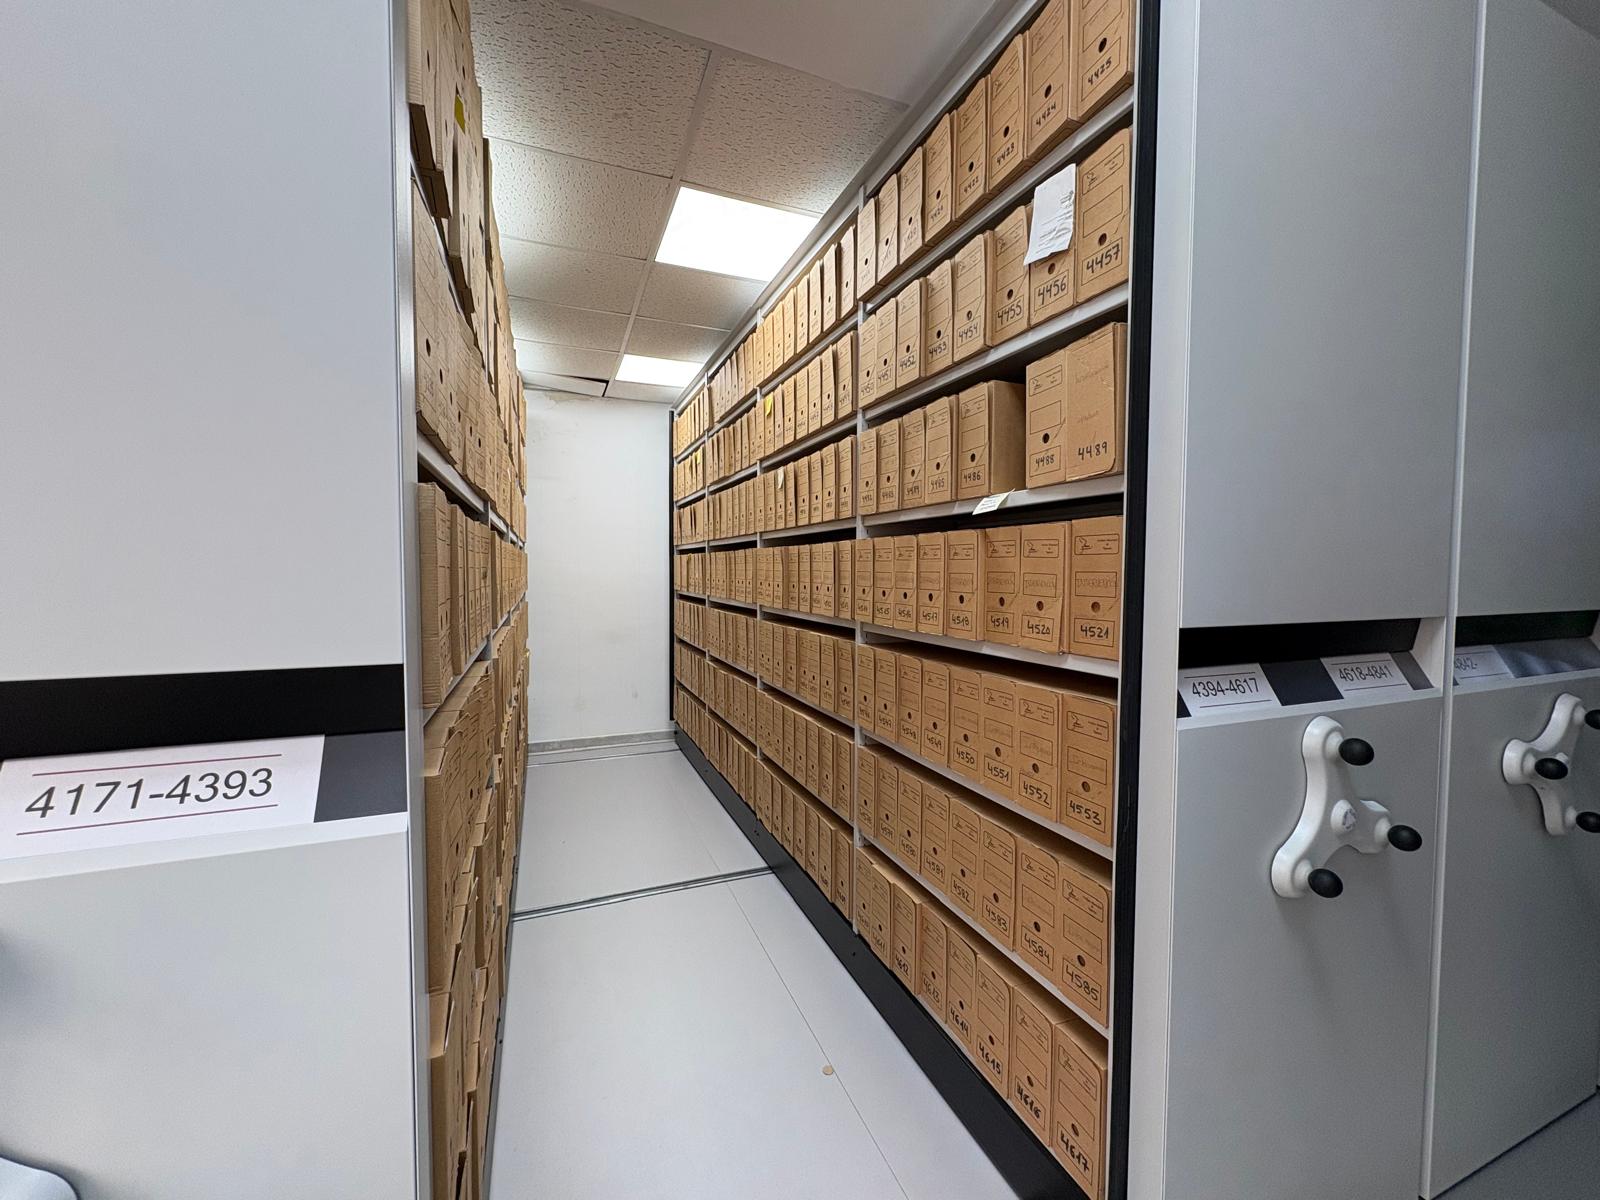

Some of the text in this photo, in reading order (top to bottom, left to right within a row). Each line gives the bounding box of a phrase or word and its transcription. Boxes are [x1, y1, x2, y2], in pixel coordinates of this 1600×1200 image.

[1088, 58, 1112, 86] 4425
[1036, 103, 1056, 126] 4424
[996, 143, 1015, 166] 4423
[1086, 246, 1120, 274] 4457
[1038, 276, 1067, 306] 4456
[998, 304, 1022, 328] 4455
[929, 342, 946, 358] 4453
[900, 355, 916, 371] 4452
[1036, 454, 1054, 468] 4488
[1078, 441, 1107, 462] 4489
[964, 470, 980, 482] 4486
[952, 615, 970, 626] 4518
[991, 616, 1008, 628] 4519
[1027, 620, 1050, 634] 4520
[1080, 624, 1109, 639] 4521
[1338, 665, 1392, 682] 4618-4841
[1192, 678, 1259, 698] 4394-4617
[926, 734, 942, 750] 4549
[956, 746, 974, 765] 4550
[987, 762, 1008, 782] 4551
[25, 768, 273, 818] 4171-4393
[1022, 781, 1048, 806] 4552
[1070, 800, 1102, 825] 4553
[953, 882, 970, 902] 4582
[985, 904, 1008, 932] 4583
[1024, 934, 1050, 964] 4584
[1066, 964, 1098, 1000] 4585
[950, 1008, 969, 1035] 4614
[978, 1042, 1001, 1074] 4615
[1017, 1079, 1041, 1118] 4616
[1060, 1131, 1090, 1172] 4617
